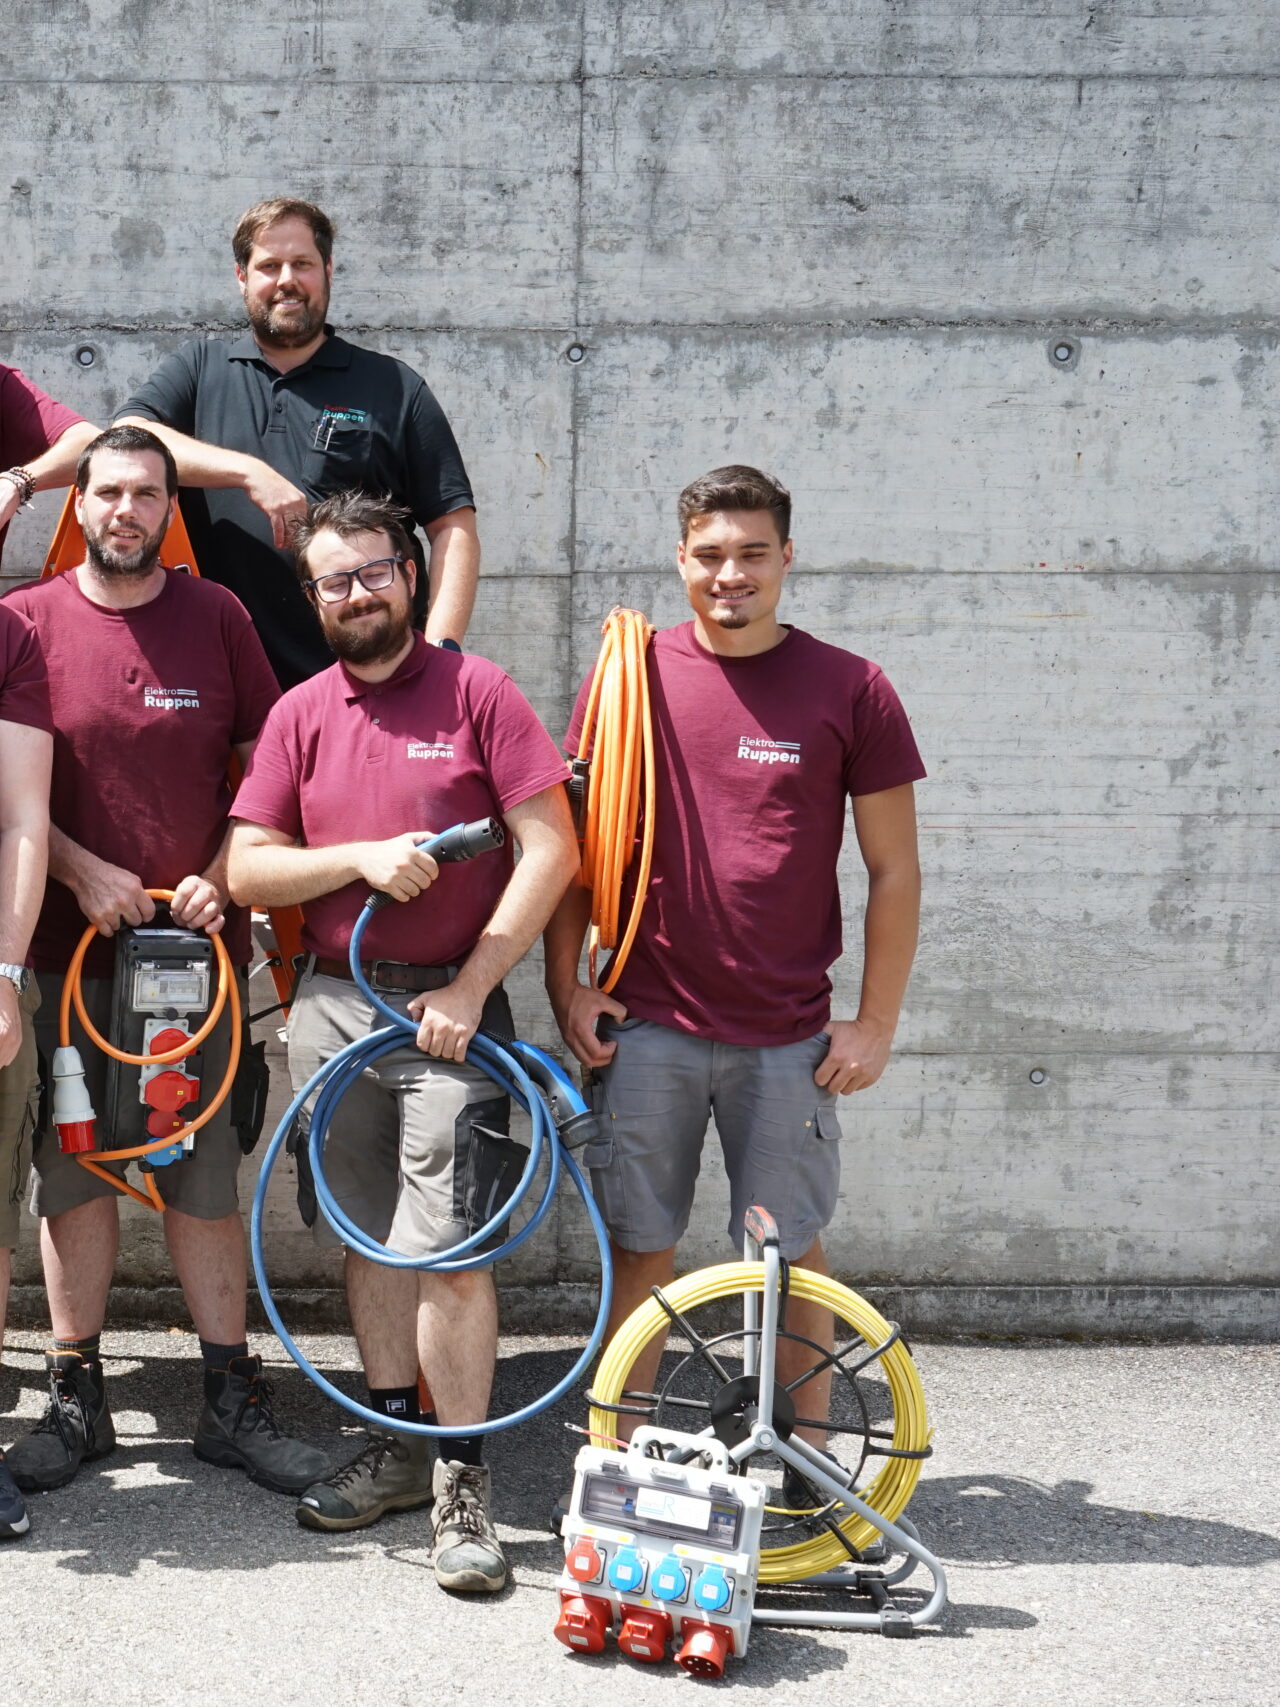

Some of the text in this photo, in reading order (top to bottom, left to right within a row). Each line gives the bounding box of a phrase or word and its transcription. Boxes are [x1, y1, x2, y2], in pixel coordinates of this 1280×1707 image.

[144, 686, 177, 695] Elektro
[145, 695, 200, 710] Ruppen
[739, 735, 776, 748] Elektro
[407, 749, 455, 760] Ruppen
[737, 745, 801, 765] Ruppen
